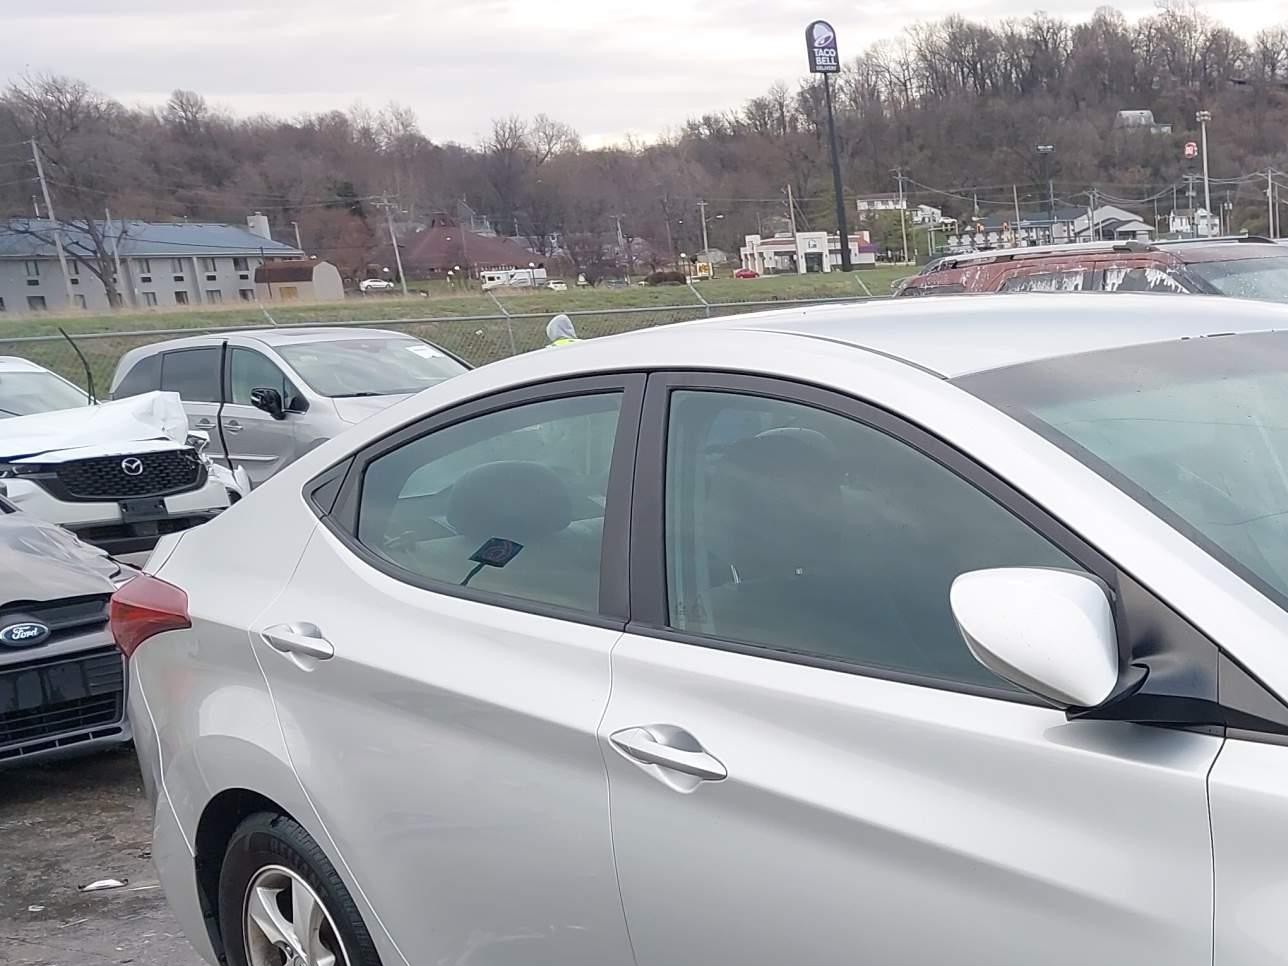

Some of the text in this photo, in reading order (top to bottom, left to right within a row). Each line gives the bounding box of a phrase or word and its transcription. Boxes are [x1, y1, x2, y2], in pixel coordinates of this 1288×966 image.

[813, 48, 836, 57] TACO
[815, 57, 837, 65] BELL
[12, 626, 38, 639] Ford
